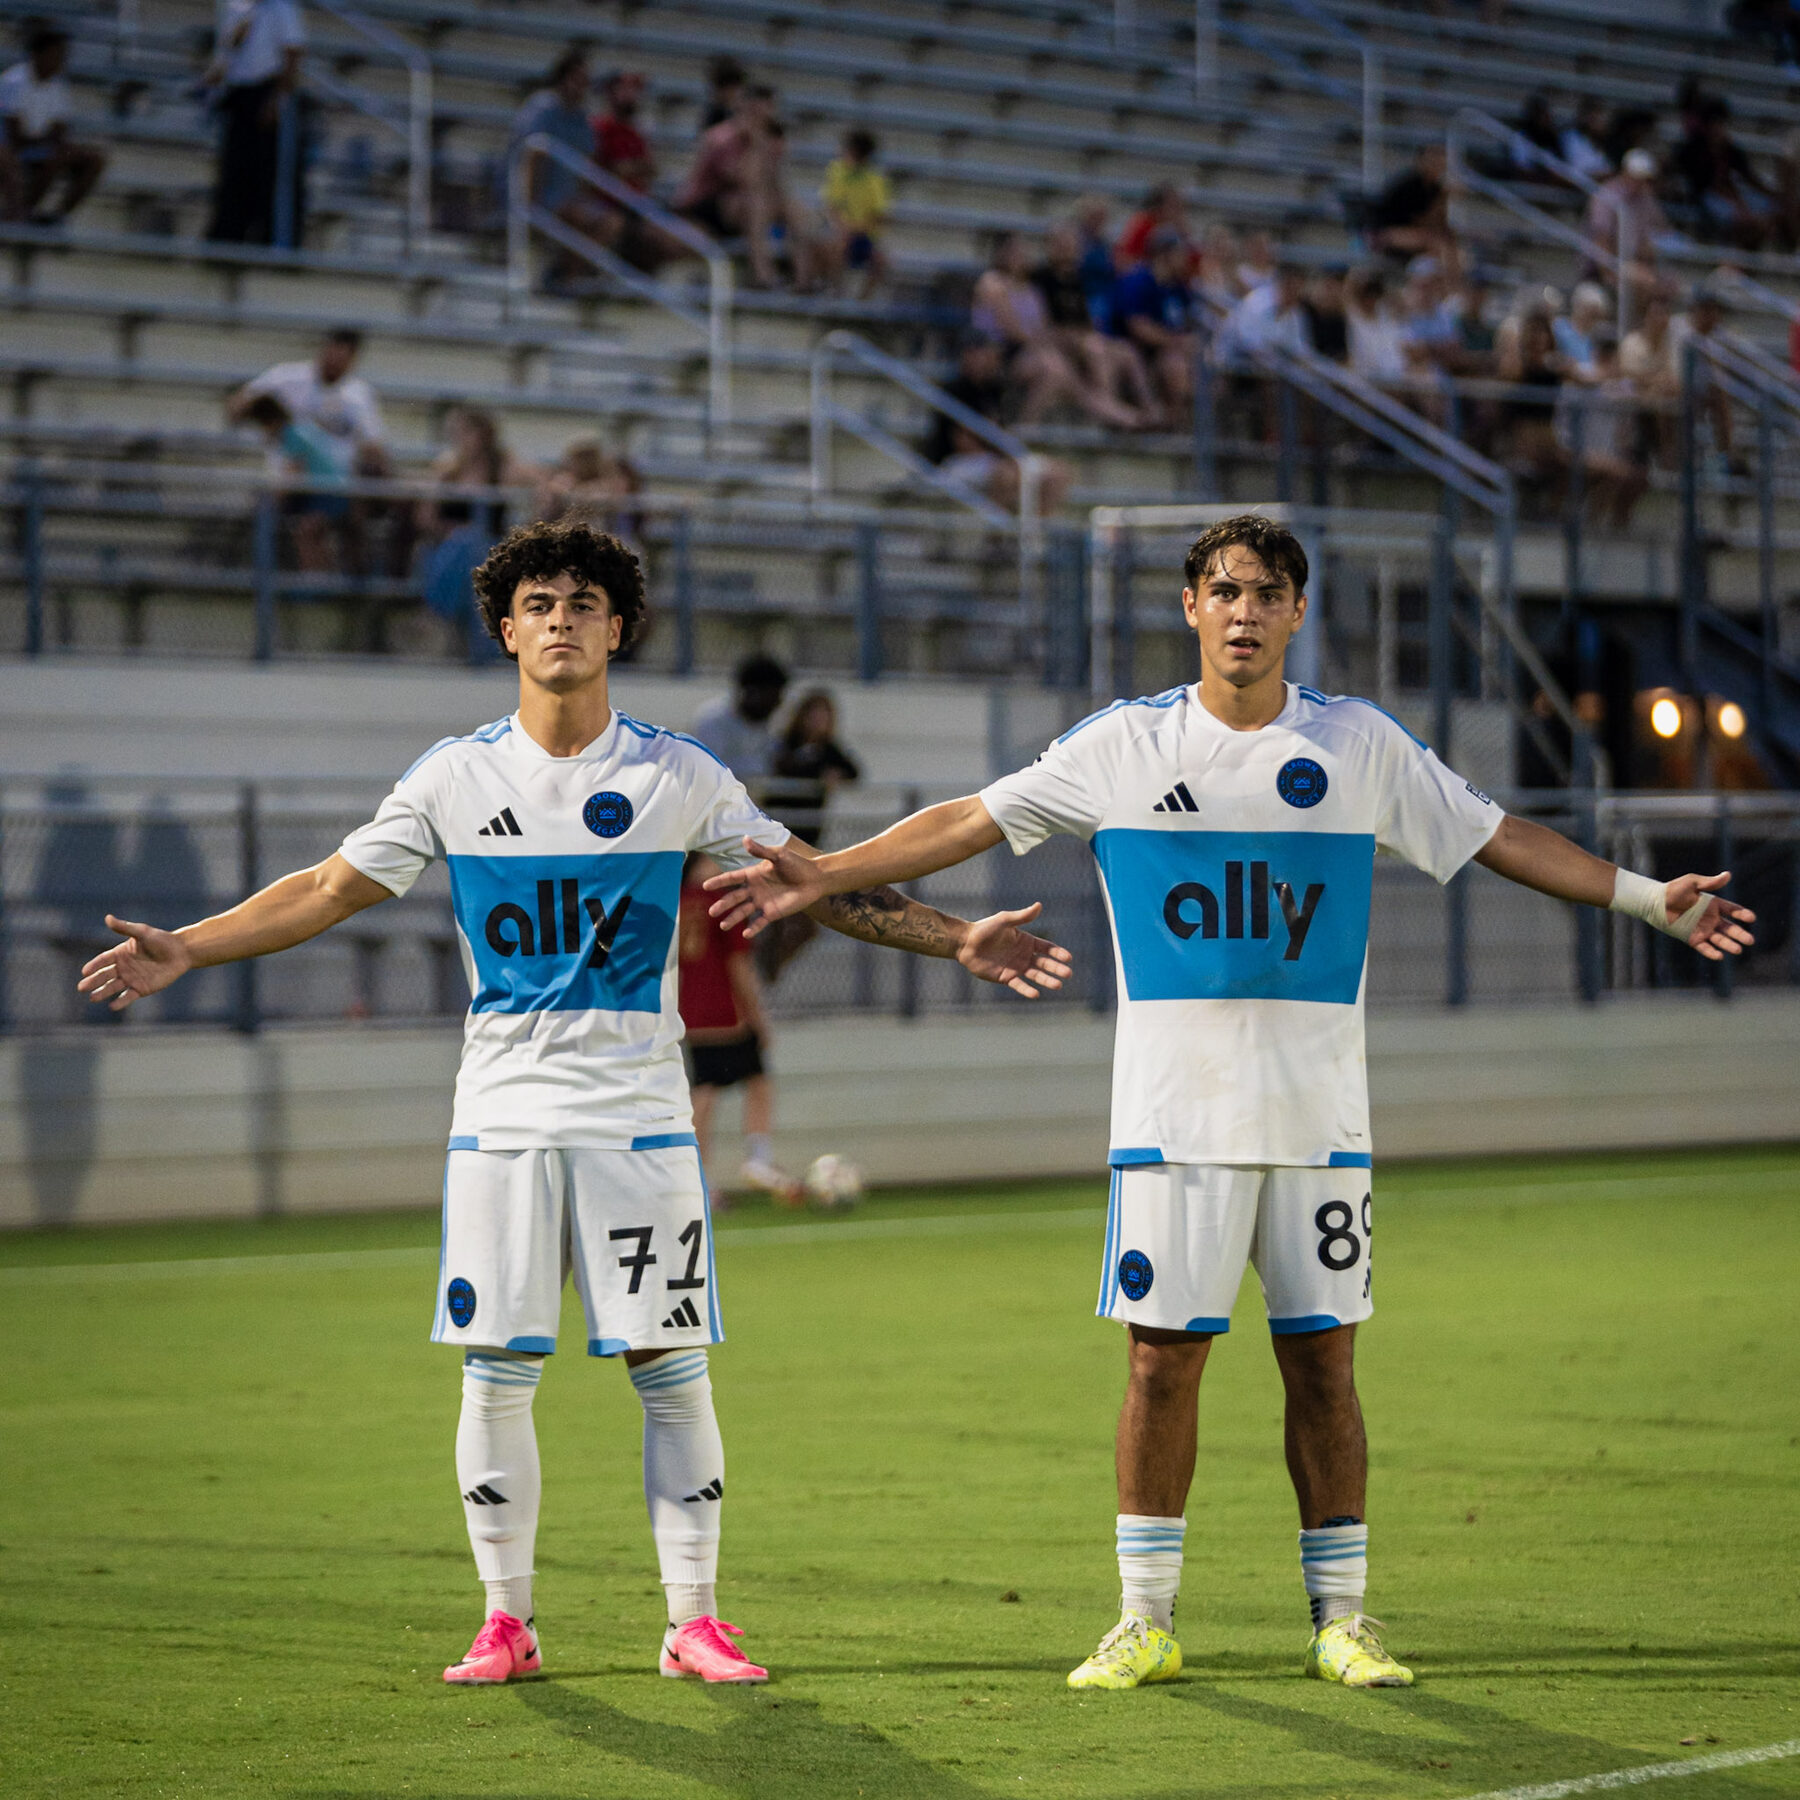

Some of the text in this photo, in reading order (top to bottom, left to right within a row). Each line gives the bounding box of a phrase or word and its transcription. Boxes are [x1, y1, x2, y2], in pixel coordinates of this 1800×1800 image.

[591, 792, 624, 803] CROWN
[591, 823, 626, 835] LEGACY
[485, 878, 633, 969] ally
[1163, 861, 1326, 961] ally
[608, 1219, 705, 1294] 71
